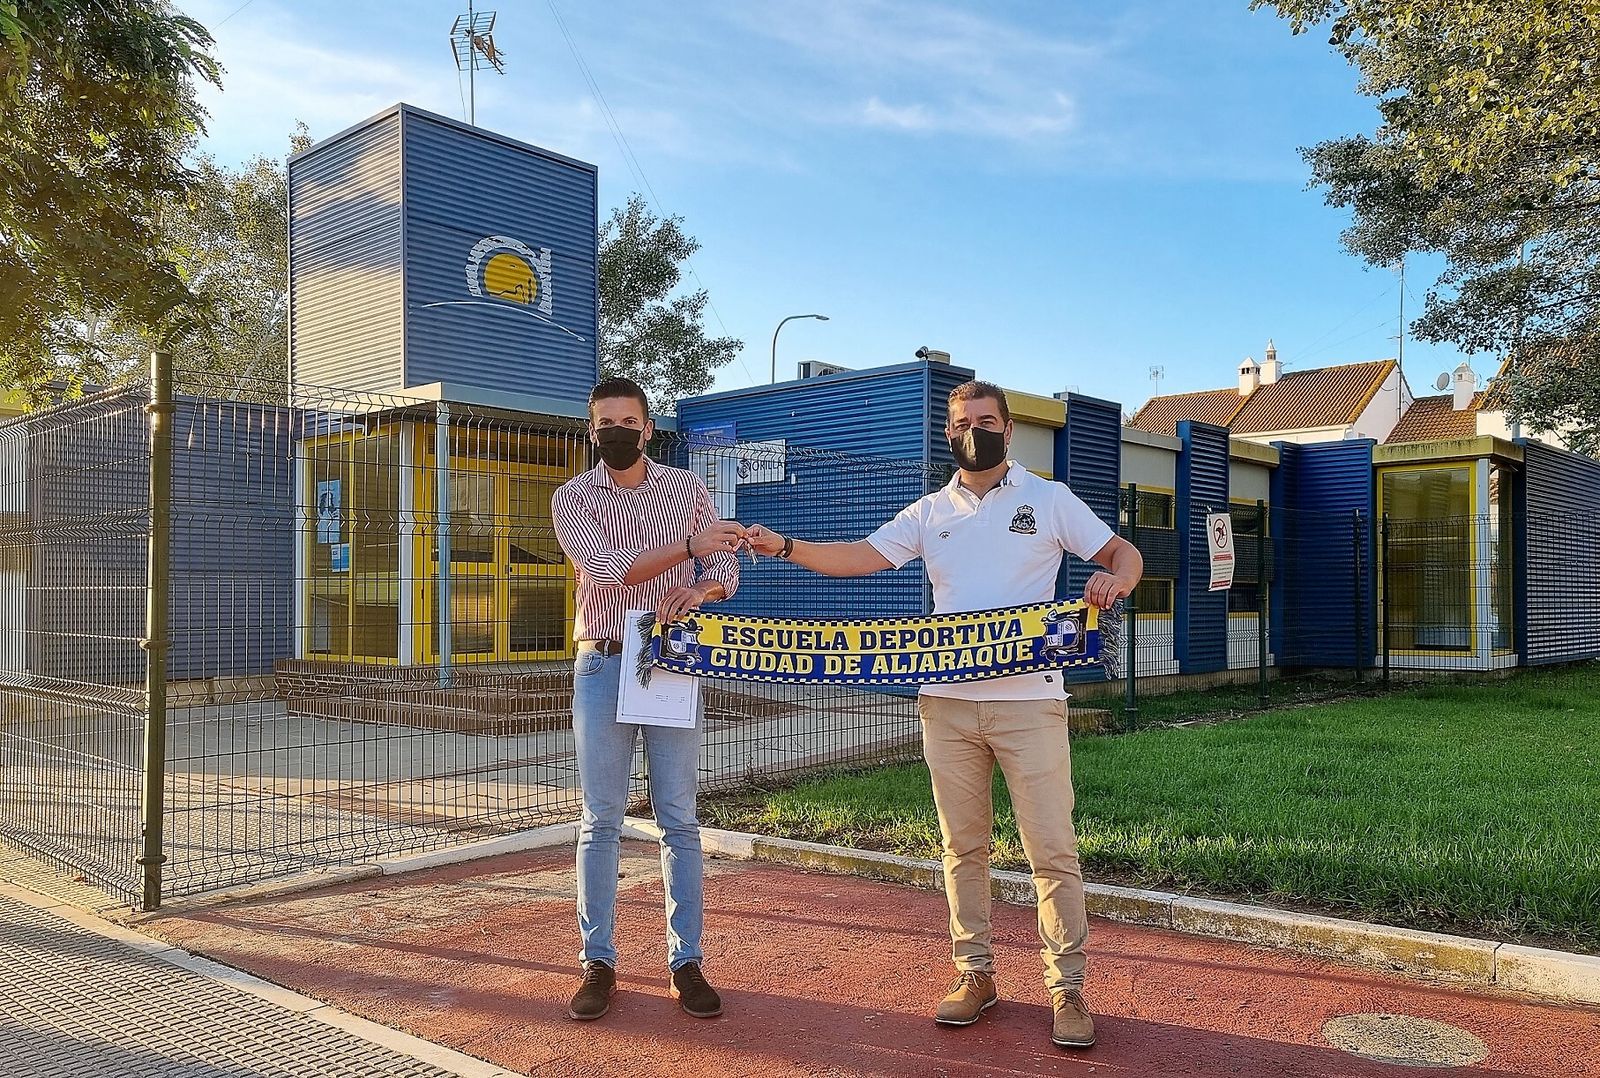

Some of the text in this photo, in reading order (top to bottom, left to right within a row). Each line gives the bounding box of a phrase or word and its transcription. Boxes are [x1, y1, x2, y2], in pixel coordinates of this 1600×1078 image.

[721, 625, 850, 651] ESCUELA
[859, 618, 1024, 651] DEPORTIVA
[710, 639, 1034, 675] CIUDAD DE ALJARAQUE
